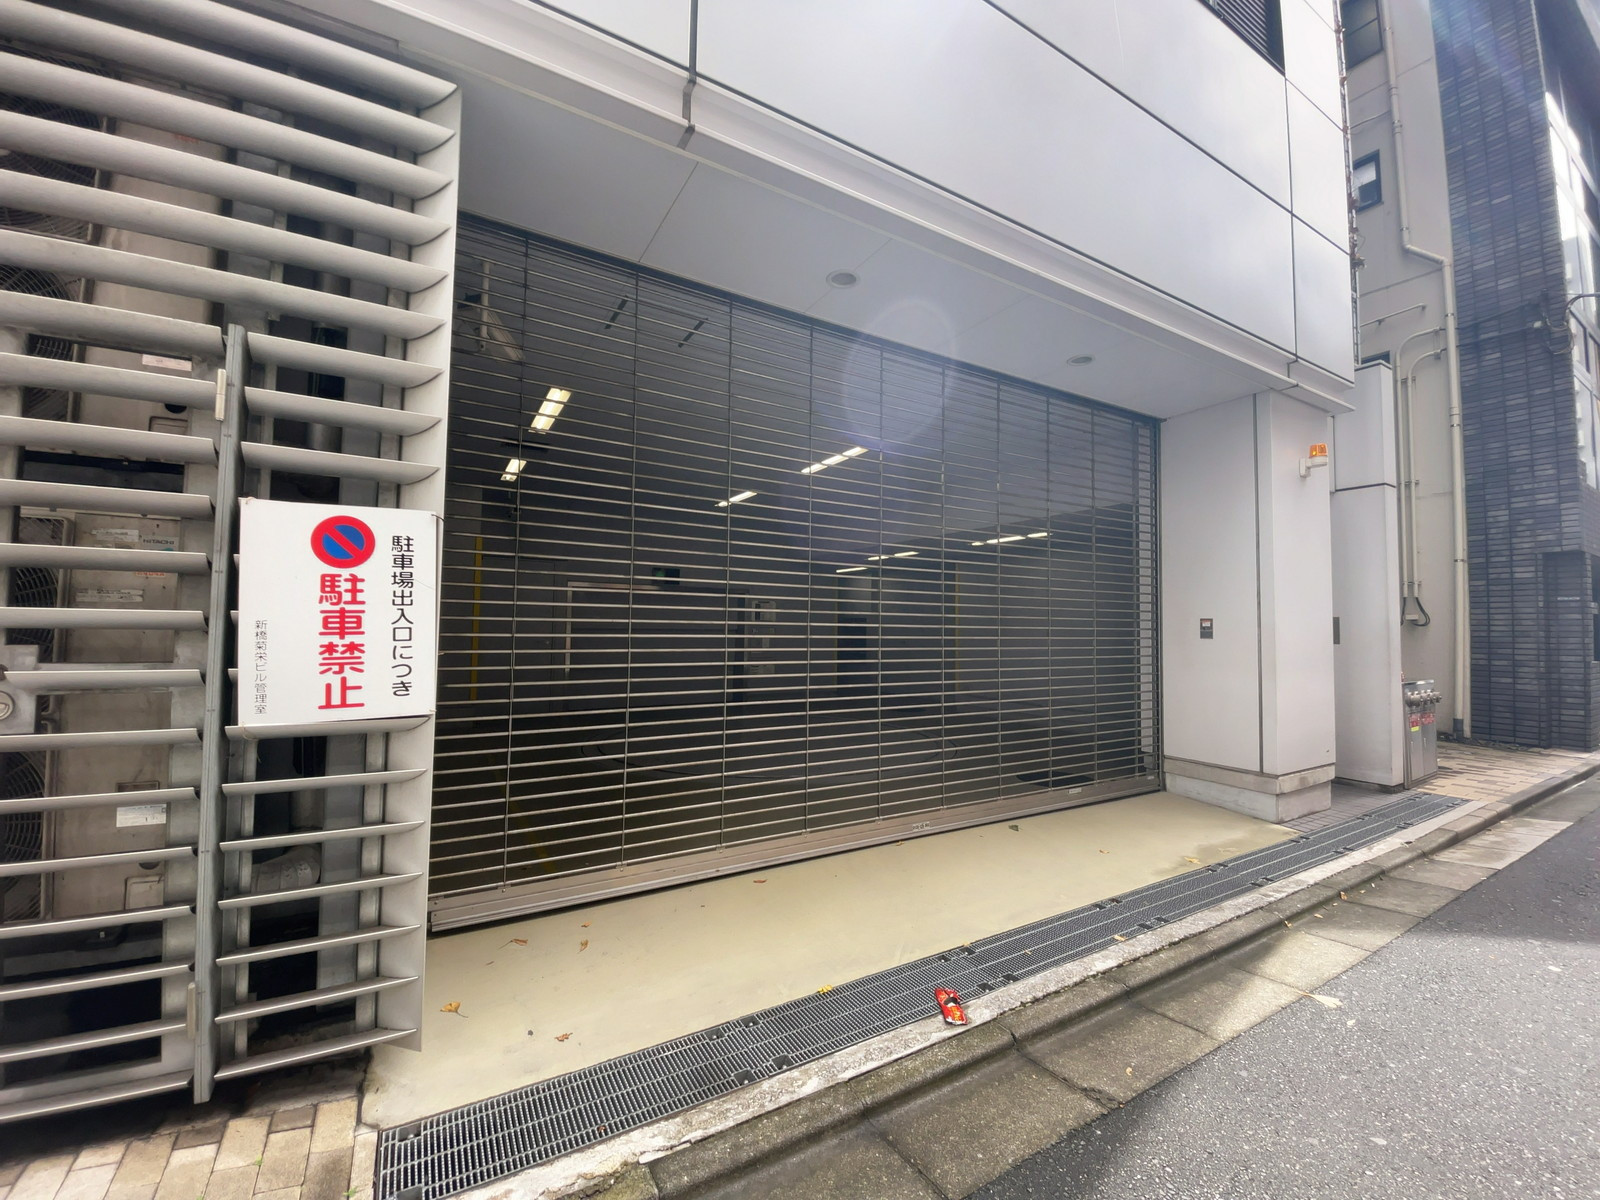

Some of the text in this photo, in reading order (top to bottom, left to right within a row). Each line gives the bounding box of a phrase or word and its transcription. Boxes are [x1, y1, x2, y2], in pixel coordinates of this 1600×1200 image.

[254, 620, 268, 715] 新橋菊栄ビル管理室
[318, 573, 366, 709] 駐車禁止
[391, 535, 415, 697] 駐車場出入口につき
